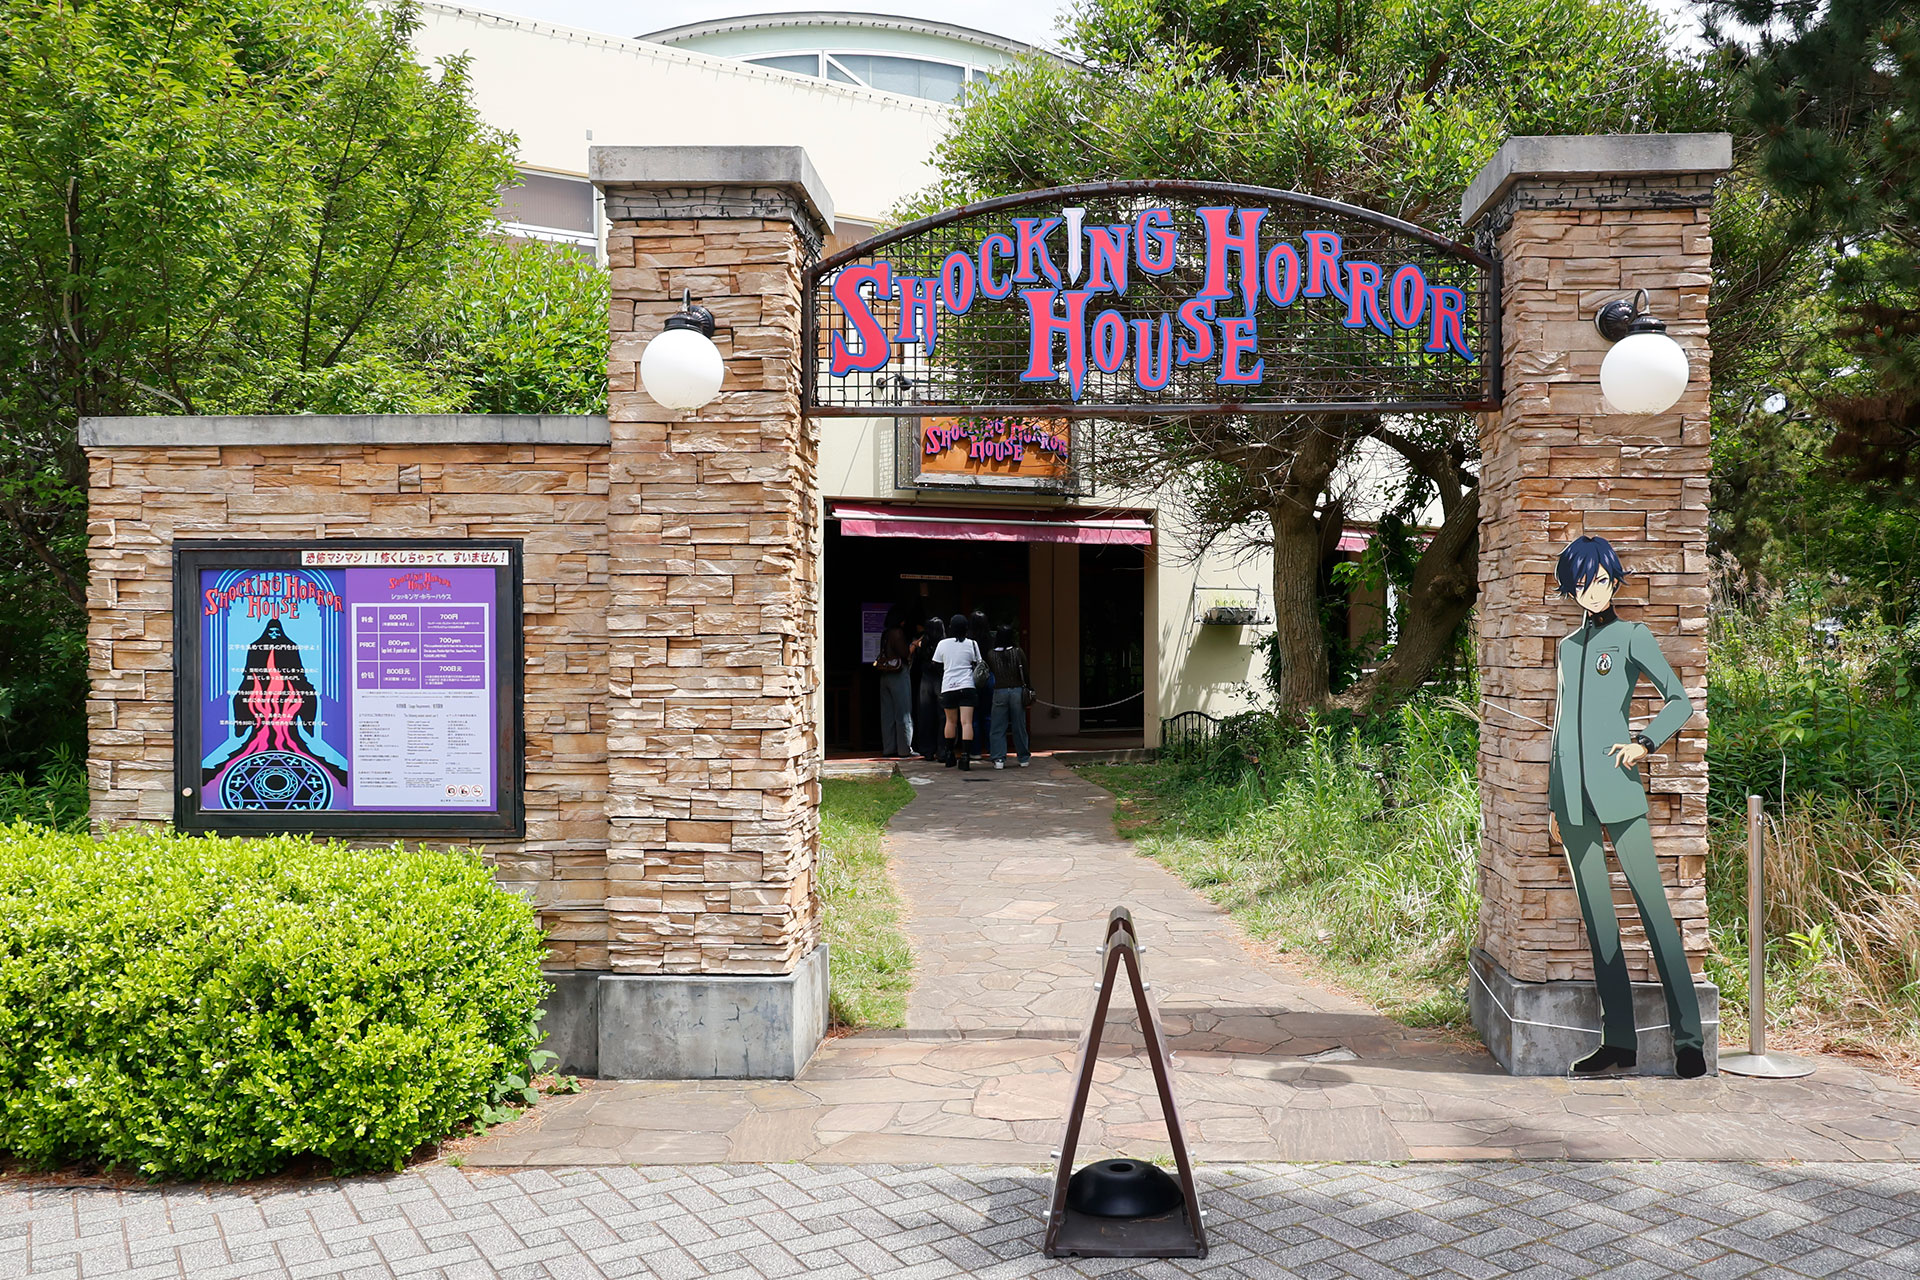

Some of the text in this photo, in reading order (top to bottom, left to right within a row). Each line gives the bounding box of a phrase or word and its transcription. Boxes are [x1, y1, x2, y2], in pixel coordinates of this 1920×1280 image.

[830, 206, 1475, 377] SHOCKING HORROR
[1019, 288, 1264, 402] HOUSE
[969, 435, 1025, 463] HOUSE
[205, 575, 344, 616] SHOCKING HORROR
[247, 595, 299, 622] HOUSE
[388, 613, 408, 621] 800円
